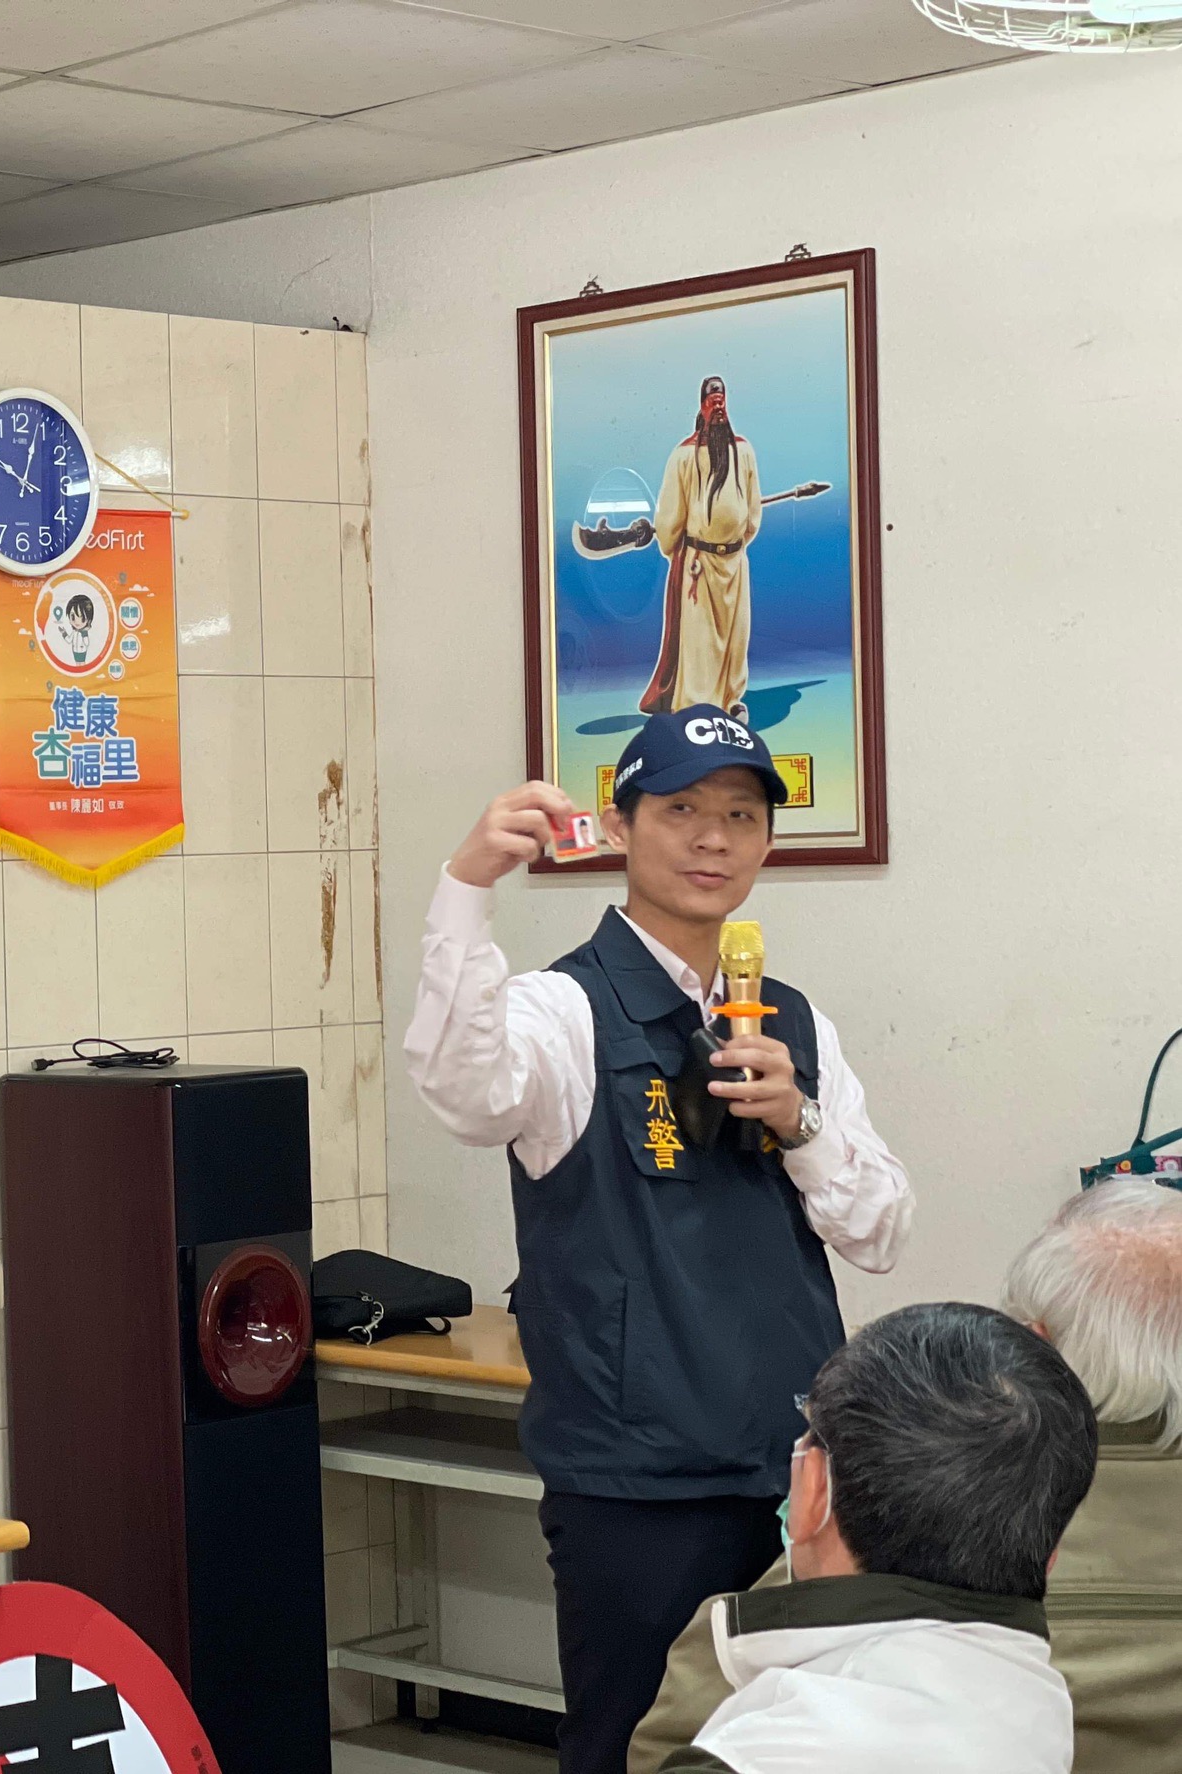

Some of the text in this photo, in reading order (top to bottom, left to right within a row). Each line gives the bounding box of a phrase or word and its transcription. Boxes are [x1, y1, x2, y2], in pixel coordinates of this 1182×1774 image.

[11, 412, 29, 433] 12
[40, 422, 46, 441] 1
[53, 445, 67, 466] 2
[59, 475, 73, 496] 3
[53, 505, 68, 525] 4
[15, 532, 30, 552] 6
[38, 526, 53, 547] 5
[85, 529, 145, 550] edFirst
[52, 687, 118, 737] 健康
[33, 728, 139, 787] 杏福里
[644, 1079, 685, 1170] 刑警
